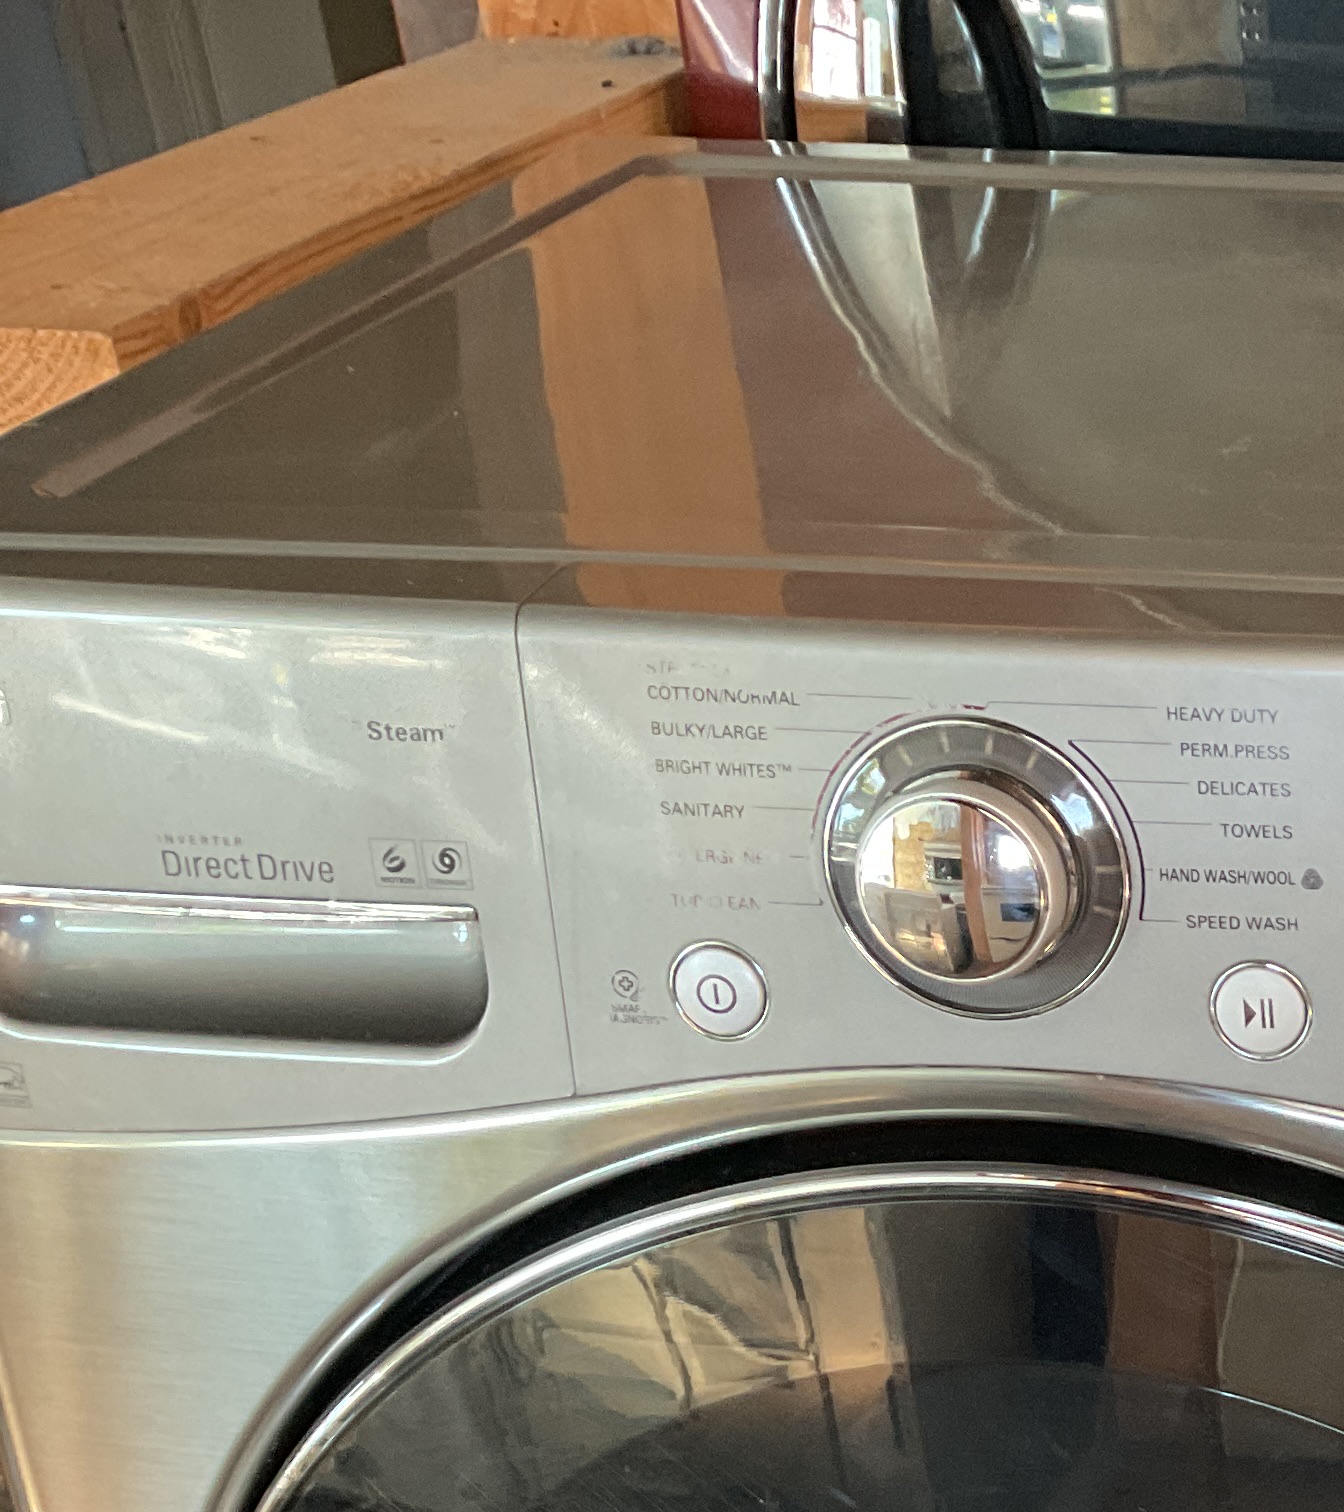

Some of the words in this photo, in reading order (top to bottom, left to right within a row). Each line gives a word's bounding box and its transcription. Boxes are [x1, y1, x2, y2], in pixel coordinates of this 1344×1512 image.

[647, 684, 800, 706] COTTON/NORMAL
[1166, 706, 1225, 722] HEAVY
[1231, 708, 1279, 725] DUTY
[650, 721, 768, 741] BULKY/LARGE
[1180, 742, 1290, 760] PERM.PRESS
[655, 758, 712, 775] BRIGHT
[1197, 780, 1292, 797] DELICATES
[660, 802, 745, 819] SANITARY
[1220, 823, 1294, 840] TOWELS
[161, 849, 253, 880] Direct
[257, 852, 335, 884] Drive
[1159, 867, 1200, 883] HAND
[1204, 869, 1296, 886] WASH/WOOL
[1186, 914, 1241, 931] SPEED
[1245, 916, 1299, 932] WASH
